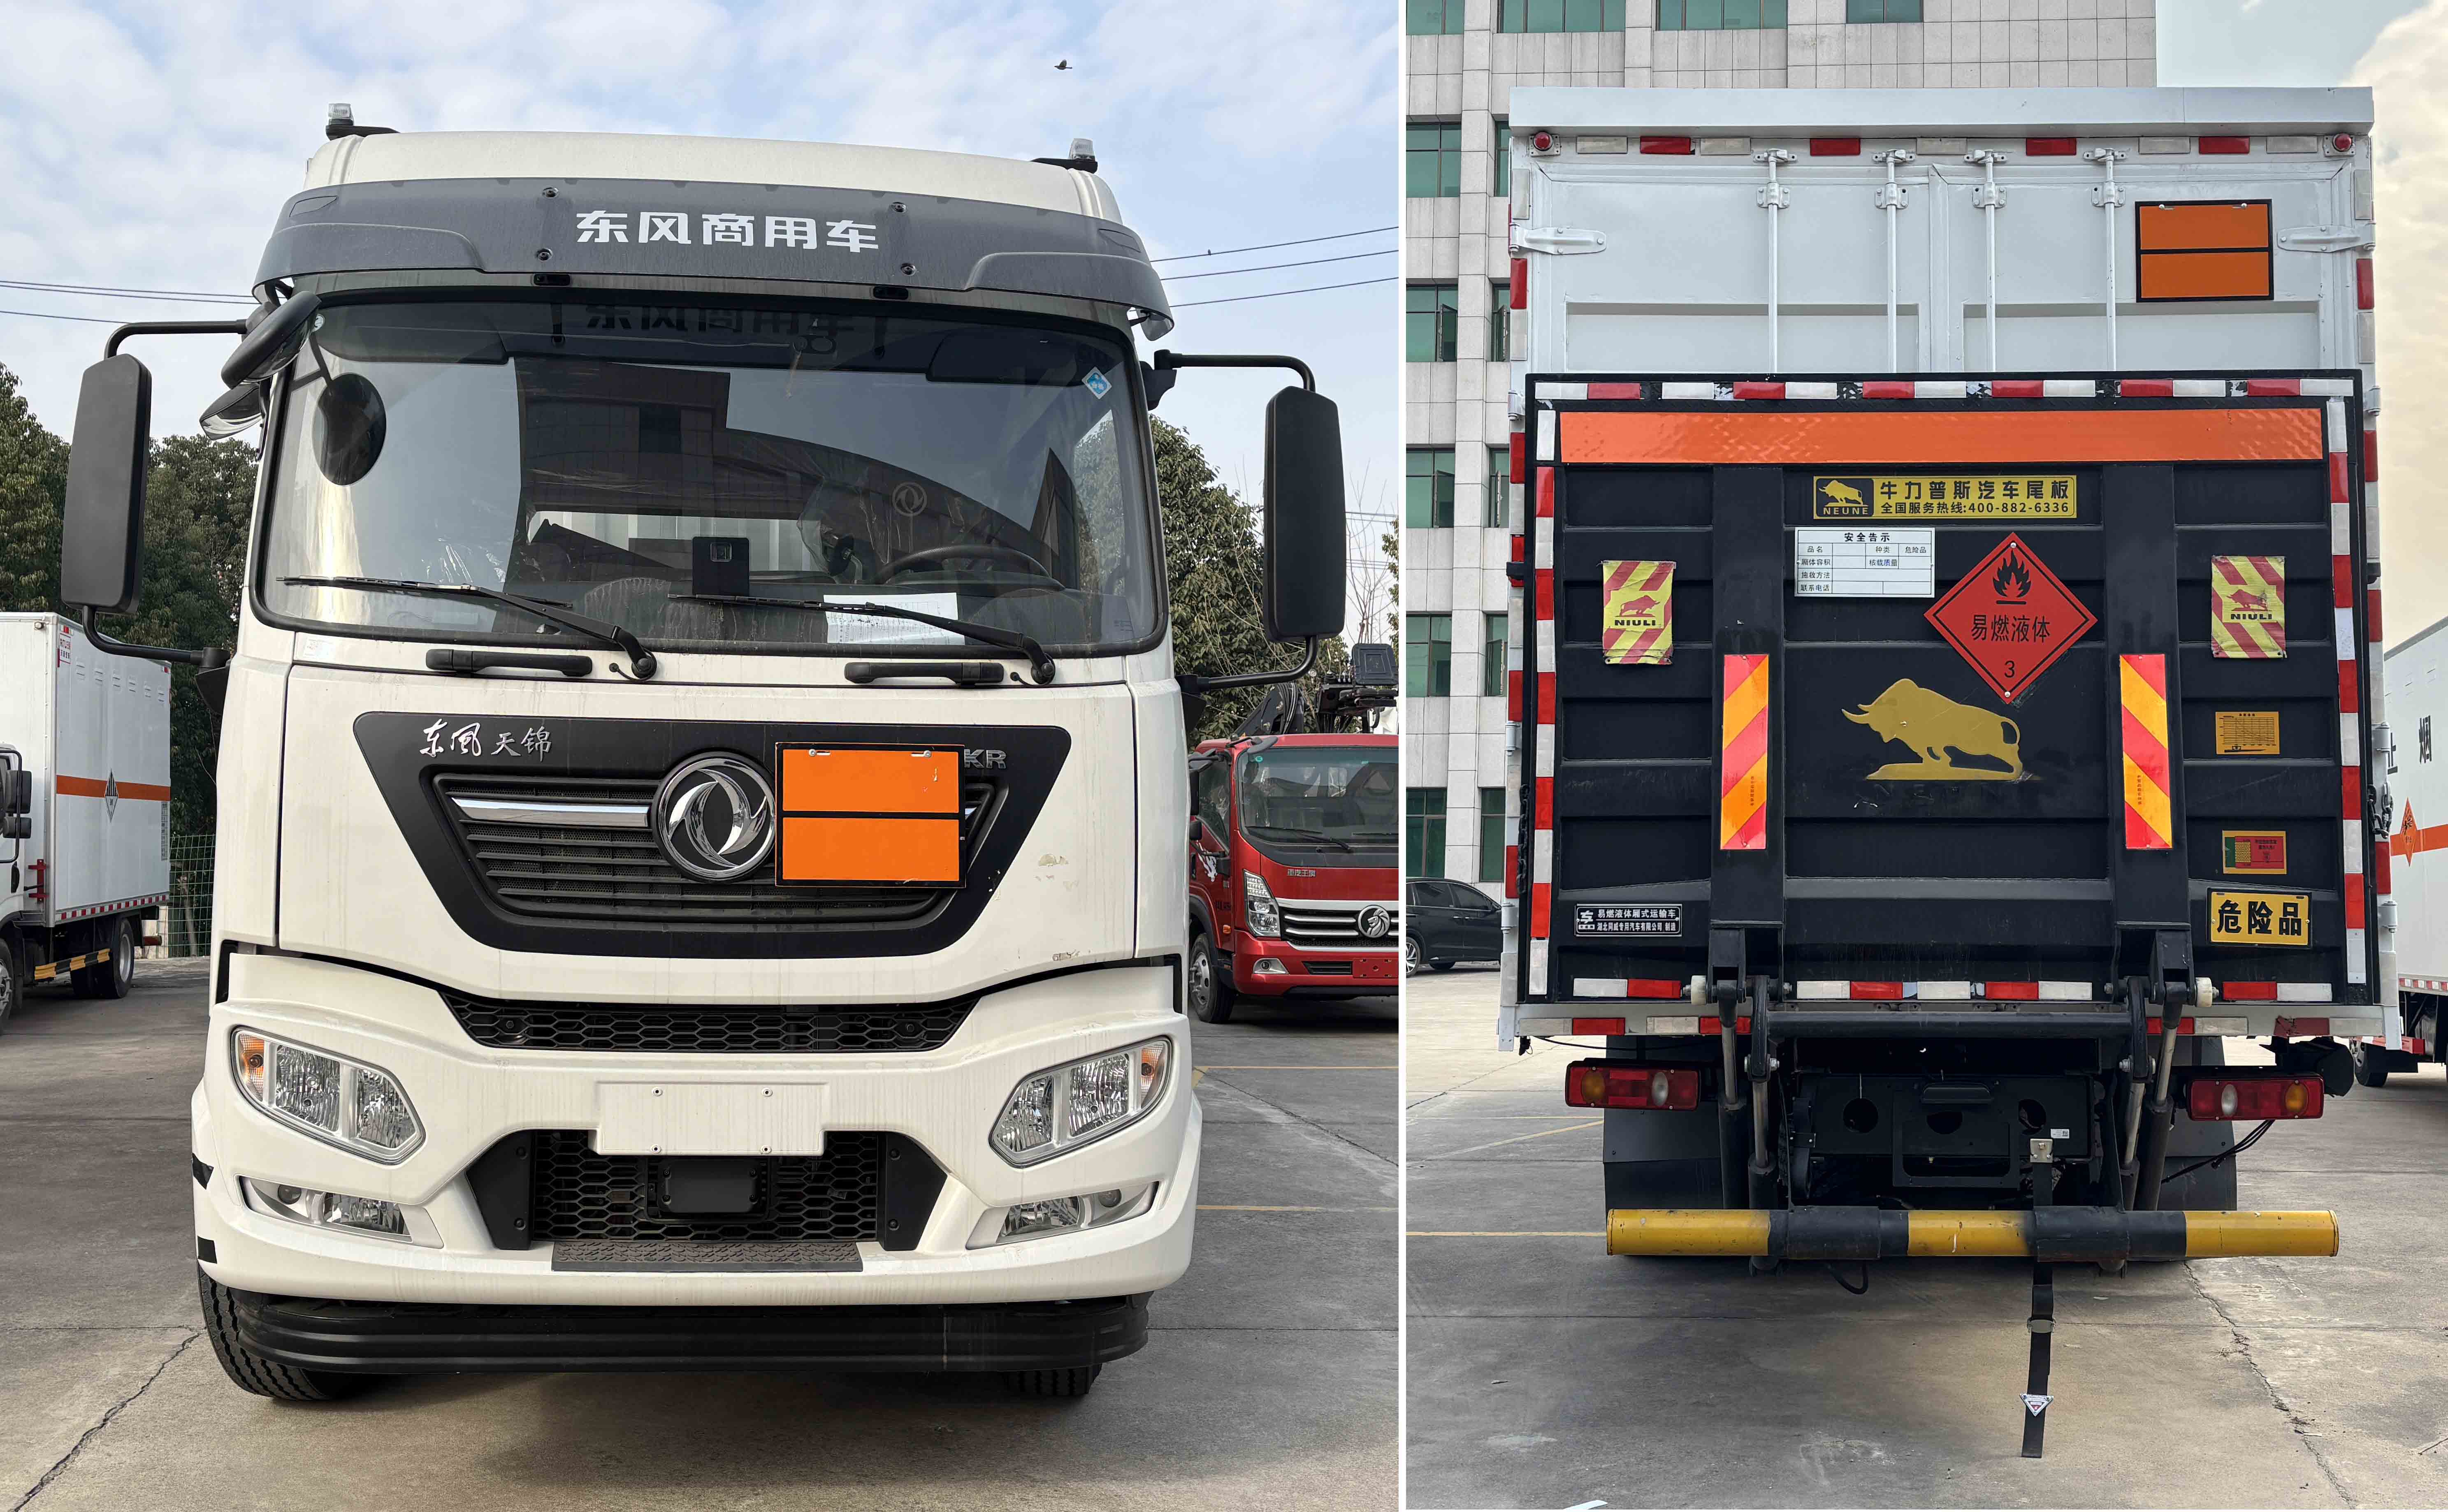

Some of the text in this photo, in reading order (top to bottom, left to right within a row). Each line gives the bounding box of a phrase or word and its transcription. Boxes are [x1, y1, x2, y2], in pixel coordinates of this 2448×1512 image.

[577, 211, 879, 253] 东风商用车
[1881, 480, 2069, 500] 牛力普斯汽车尾板
[1844, 532, 1890, 542] 安全告示
[1970, 614, 2051, 643] 易燃液体
[2004, 661, 2015, 678] 3
[490, 726, 552, 763] 天锦
[1598, 909, 1676, 918] 易燃液体厢式运输车
[2217, 900, 2302, 936] 危险品
